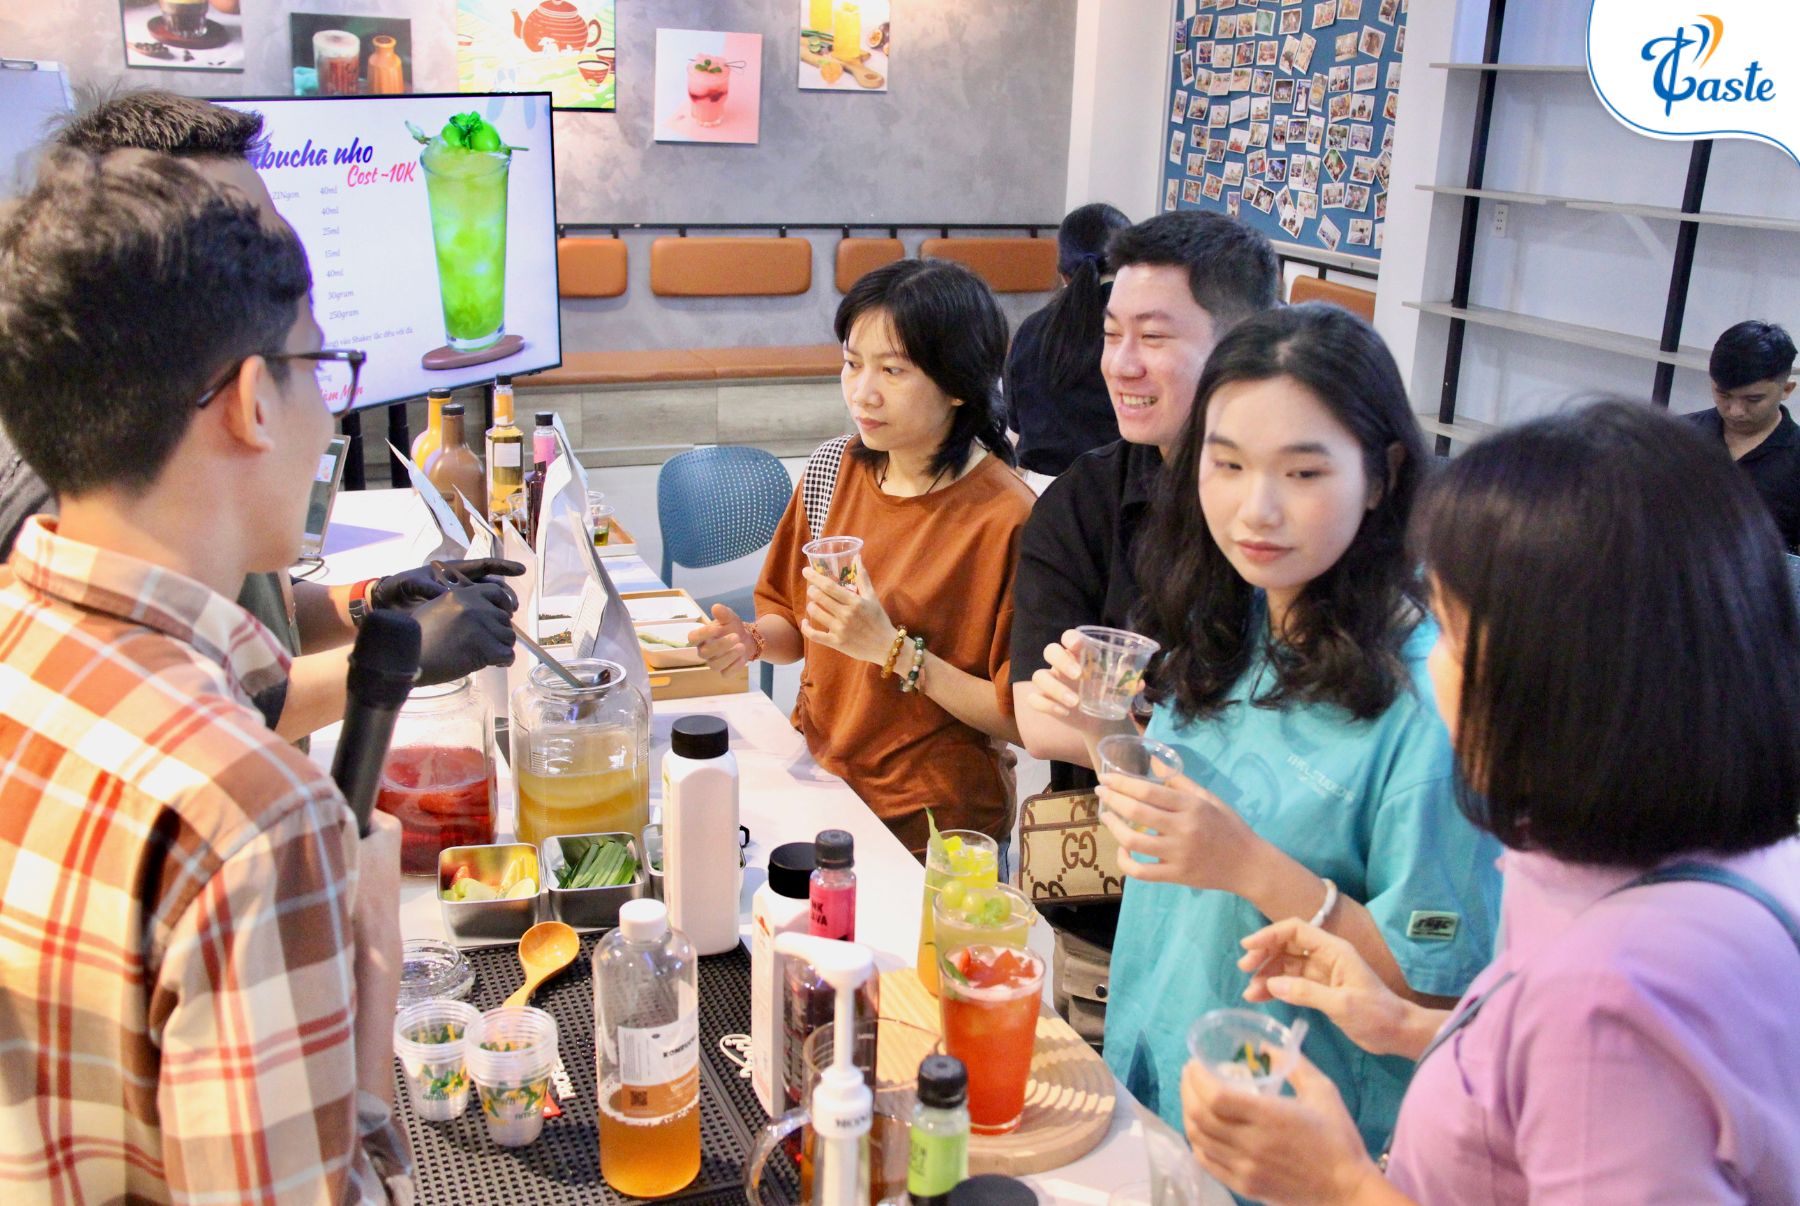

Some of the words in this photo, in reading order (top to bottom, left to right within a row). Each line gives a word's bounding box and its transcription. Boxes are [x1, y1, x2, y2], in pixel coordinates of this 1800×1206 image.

[252, 138, 329, 170] bucha
[333, 137, 373, 165] nho
[347, 164, 379, 188] Cost
